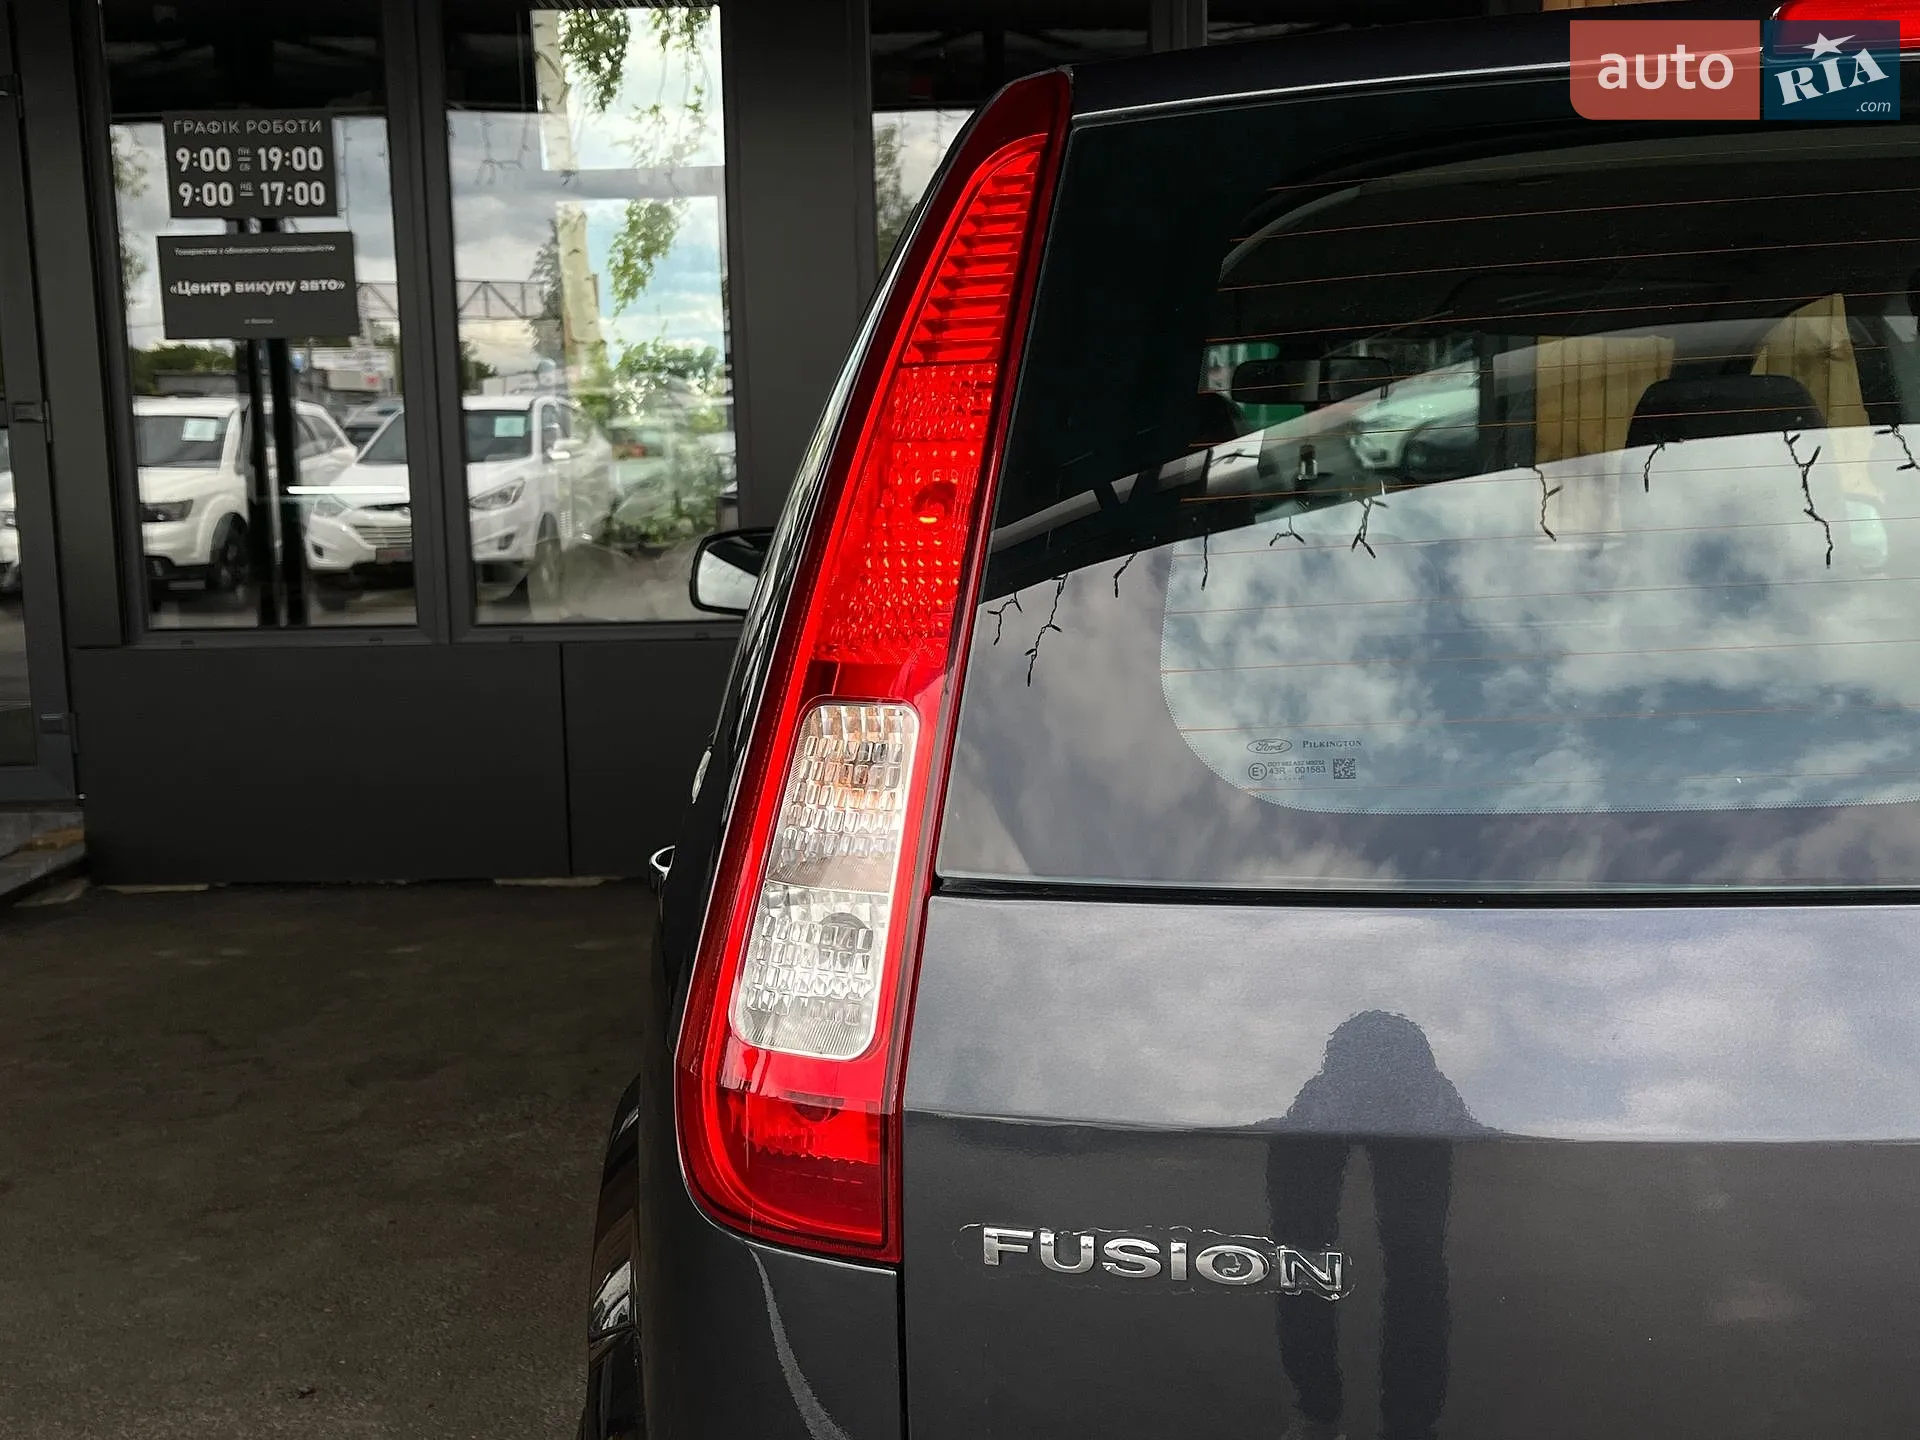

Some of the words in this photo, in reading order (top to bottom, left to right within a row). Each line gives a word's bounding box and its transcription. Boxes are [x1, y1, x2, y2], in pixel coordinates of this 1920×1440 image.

[173, 119, 240, 134] ГРАФІК
[246, 119, 323, 134] РОБОТИ
[175, 146, 232, 172] 9:00
[257, 146, 324, 172] 19:00
[178, 181, 234, 207] 9:00
[259, 181, 326, 207] 17:00
[170, 280, 232, 296] «Центр
[235, 279, 296, 295] викупу
[300, 278, 345, 292] авто»
[983, 1226, 1343, 1292] FUSION
